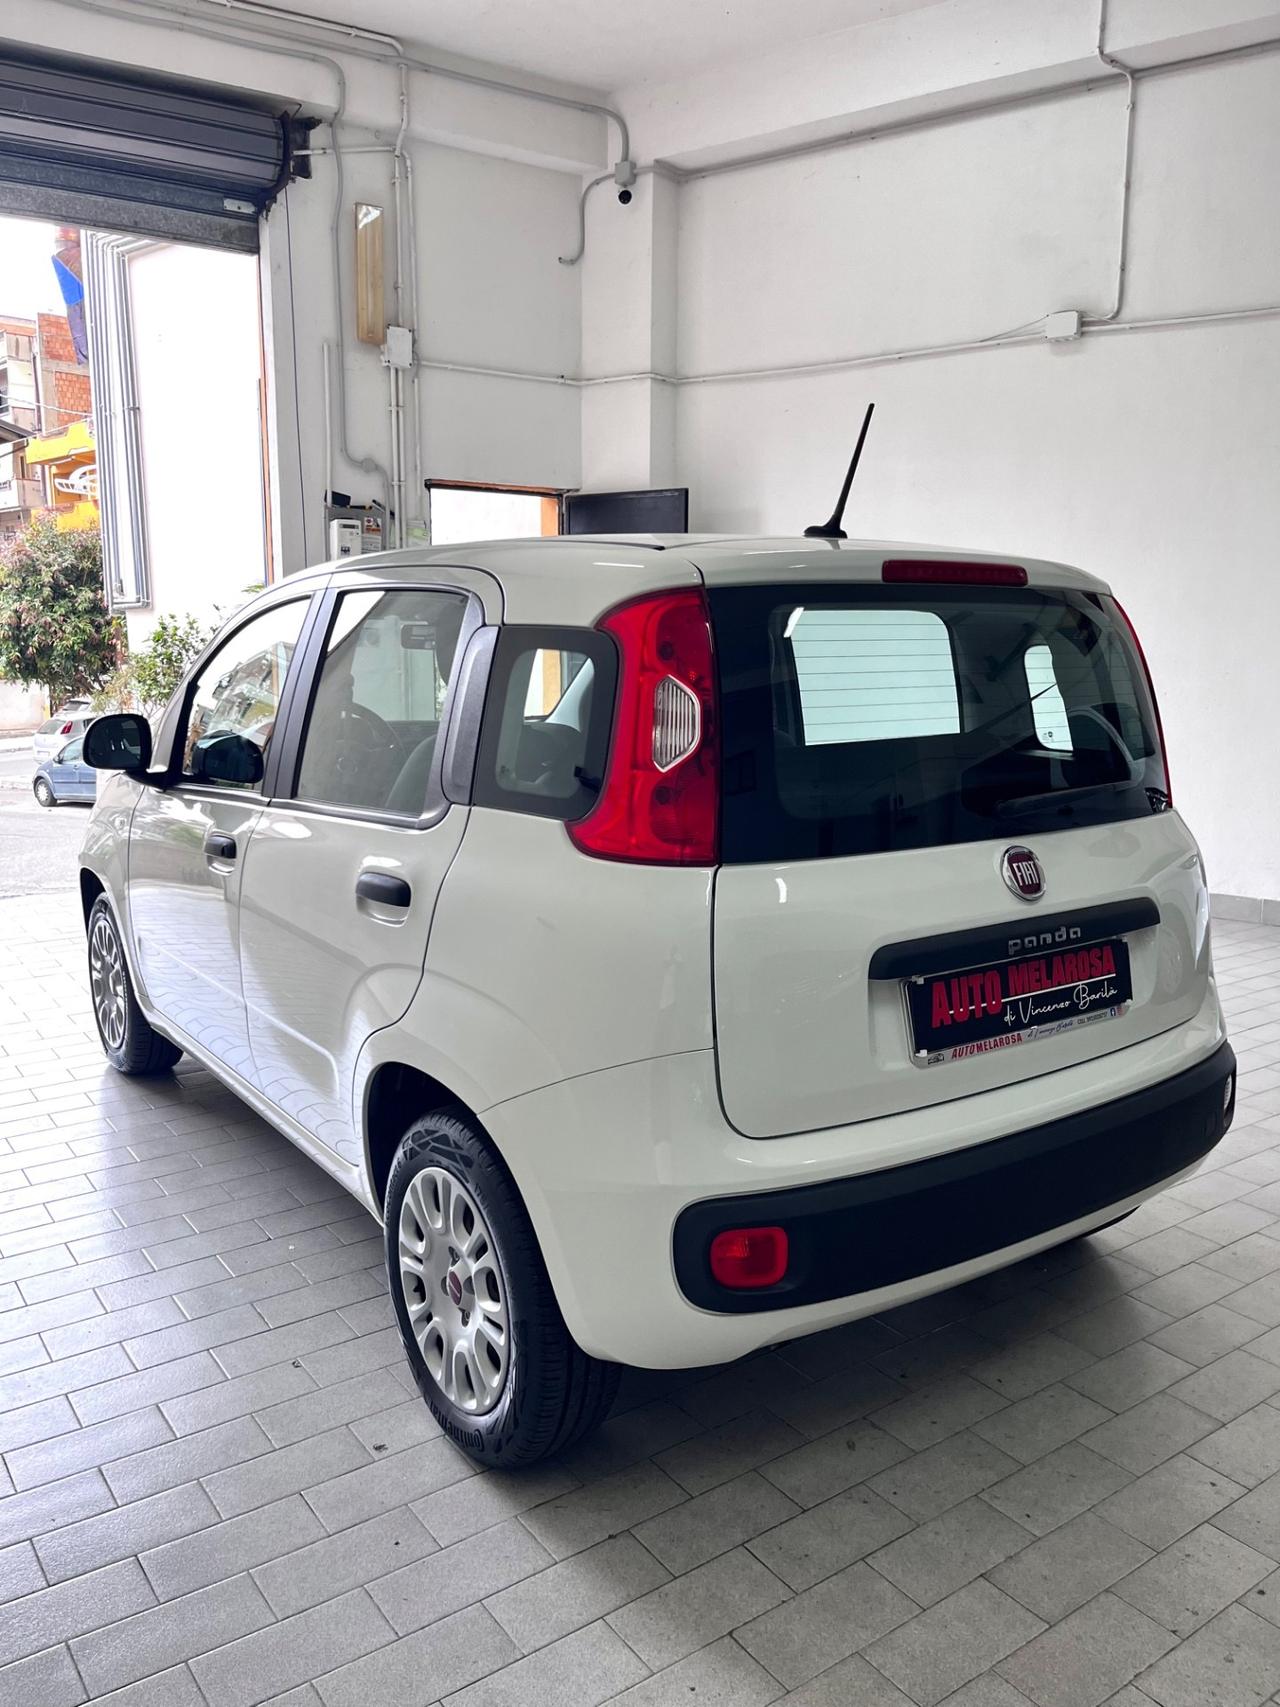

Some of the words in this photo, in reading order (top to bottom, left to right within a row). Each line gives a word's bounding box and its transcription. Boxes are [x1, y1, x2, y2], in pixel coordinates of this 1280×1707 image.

[1012, 861, 1040, 886] FIAT
[1008, 926, 1081, 955] panda
[931, 970, 1003, 1029] AUTO
[1008, 945, 1117, 997] MELAROSA
[1004, 1004, 1016, 1027] di
[1019, 997, 1071, 1024] Vincenzo
